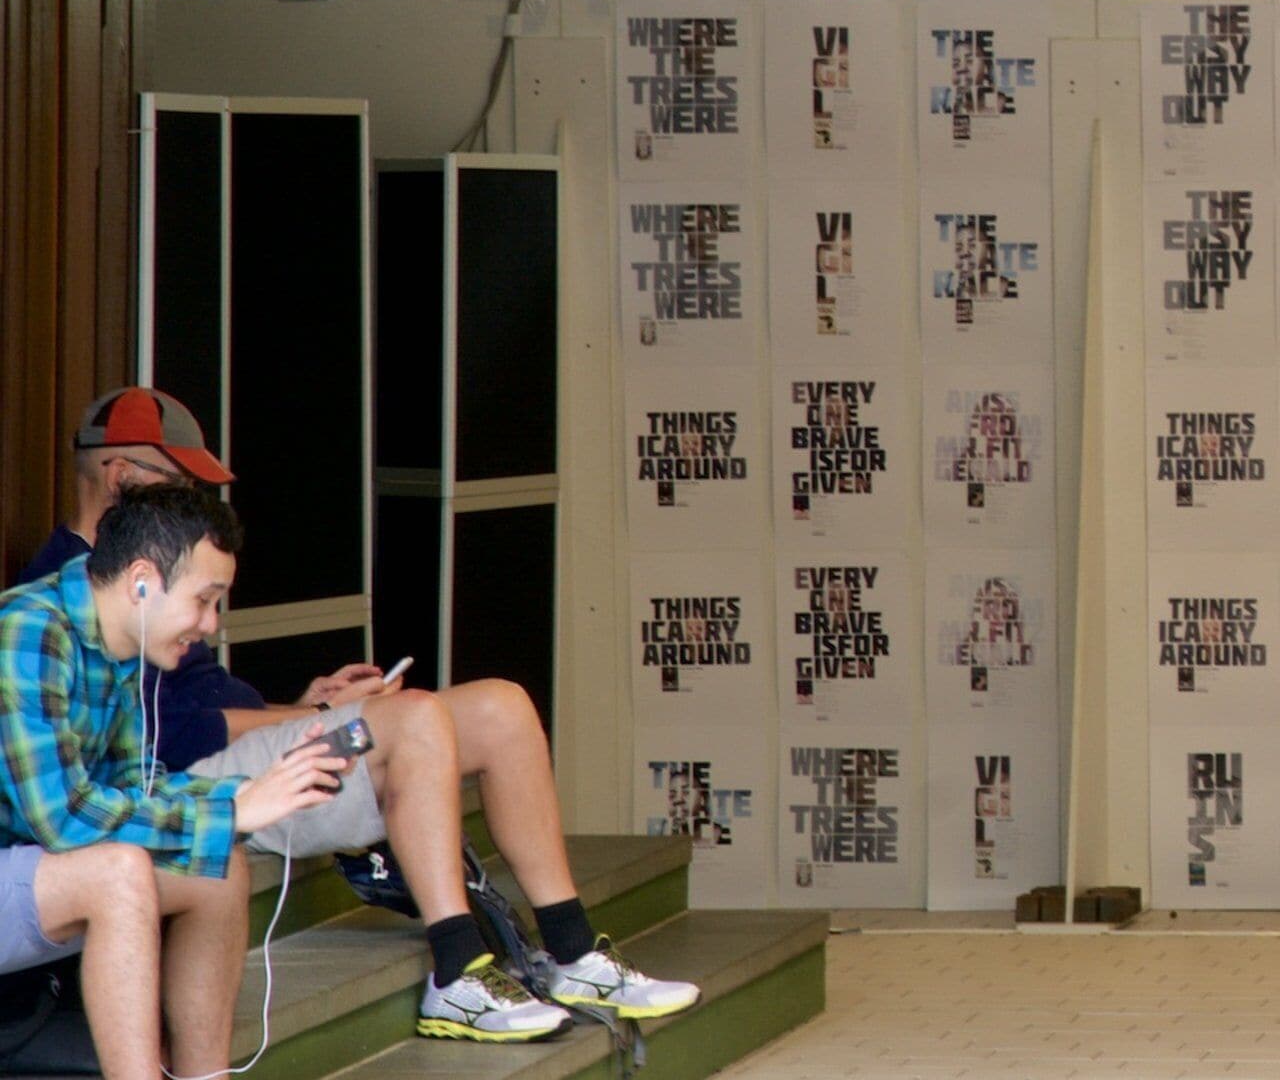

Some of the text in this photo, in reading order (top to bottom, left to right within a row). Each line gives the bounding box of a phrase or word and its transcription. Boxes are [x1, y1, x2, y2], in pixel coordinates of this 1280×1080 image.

[628, 18, 737, 47] WHERE
[1183, 5, 1250, 34] THE
[813, 27, 849, 56] VI
[931, 30, 994, 58] THE
[1161, 35, 1249, 64] EASY
[650, 47, 716, 76] THE
[628, 76, 738, 105] TREES
[1185, 65, 1251, 94] WAY
[813, 89, 833, 118] L
[1162, 96, 1229, 124] OUT
[651, 105, 739, 134] WERE
[631, 205, 740, 232] WHERE
[1185, 191, 1252, 220] THE
[816, 212, 852, 242] VI
[934, 215, 998, 241] THE
[1164, 221, 1251, 250] EASY
[653, 234, 719, 261] THE
[631, 263, 741, 291] TREES
[1187, 251, 1253, 279] WAY
[816, 275, 836, 304] L
[1164, 281, 1230, 309] OUT
[654, 291, 742, 320] WERE
[792, 381, 876, 404] EVERY
[646, 412, 737, 434] THINGS
[806, 405, 858, 426] ONE
[1166, 413, 1255, 435] THINGS
[791, 427, 879, 449] BRAVE
[639, 458, 747, 480] AROUND
[793, 472, 872, 494] GIVEN
[1157, 459, 1265, 481] AROUND
[794, 567, 878, 589] EVERY
[650, 597, 741, 619] THINGS
[809, 589, 861, 612] ONE
[1168, 598, 1258, 620] THINGS
[795, 612, 882, 635] BRAVE
[641, 643, 751, 666] AROUND
[1159, 644, 1267, 666] AROUND
[795, 658, 876, 680] GIVEN
[648, 762, 711, 789] THE
[790, 748, 899, 776] WHERE
[975, 756, 1011, 786] VI
[1187, 753, 1242, 789] RU
[812, 777, 877, 805] THE
[790, 806, 898, 834] TREES
[1187, 790, 1242, 825] IN
[975, 819, 995, 847] L
[812, 834, 898, 863] WERE
